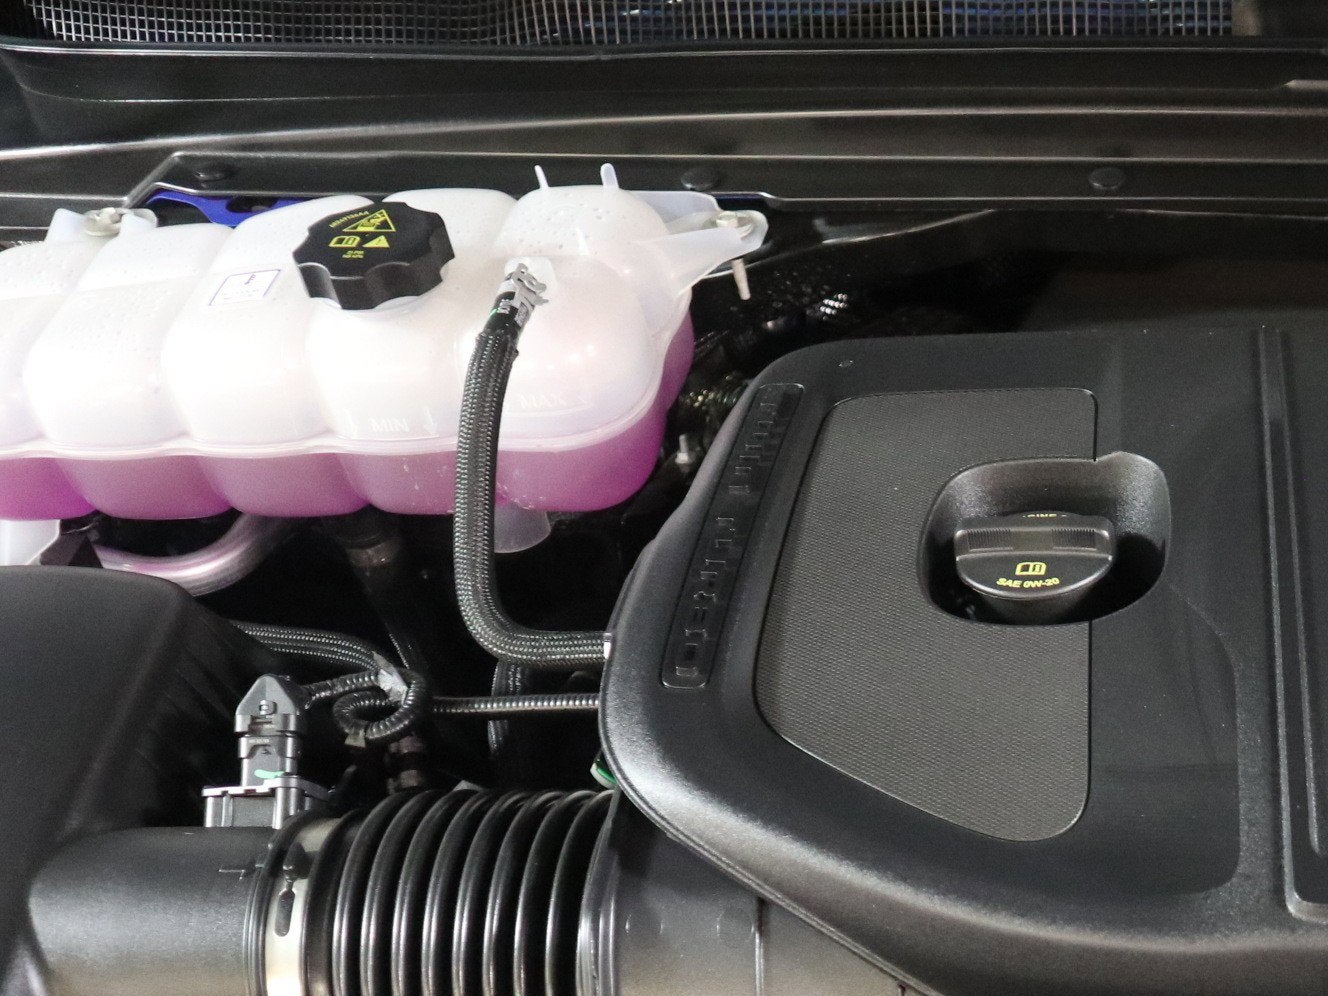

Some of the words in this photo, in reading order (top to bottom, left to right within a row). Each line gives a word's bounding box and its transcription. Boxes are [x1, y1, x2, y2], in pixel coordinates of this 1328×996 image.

[520, 393, 567, 410] MAX
[371, 417, 408, 433] MIN
[996, 577, 1022, 588] SAE
[1023, 577, 1060, 588] 0W-20
